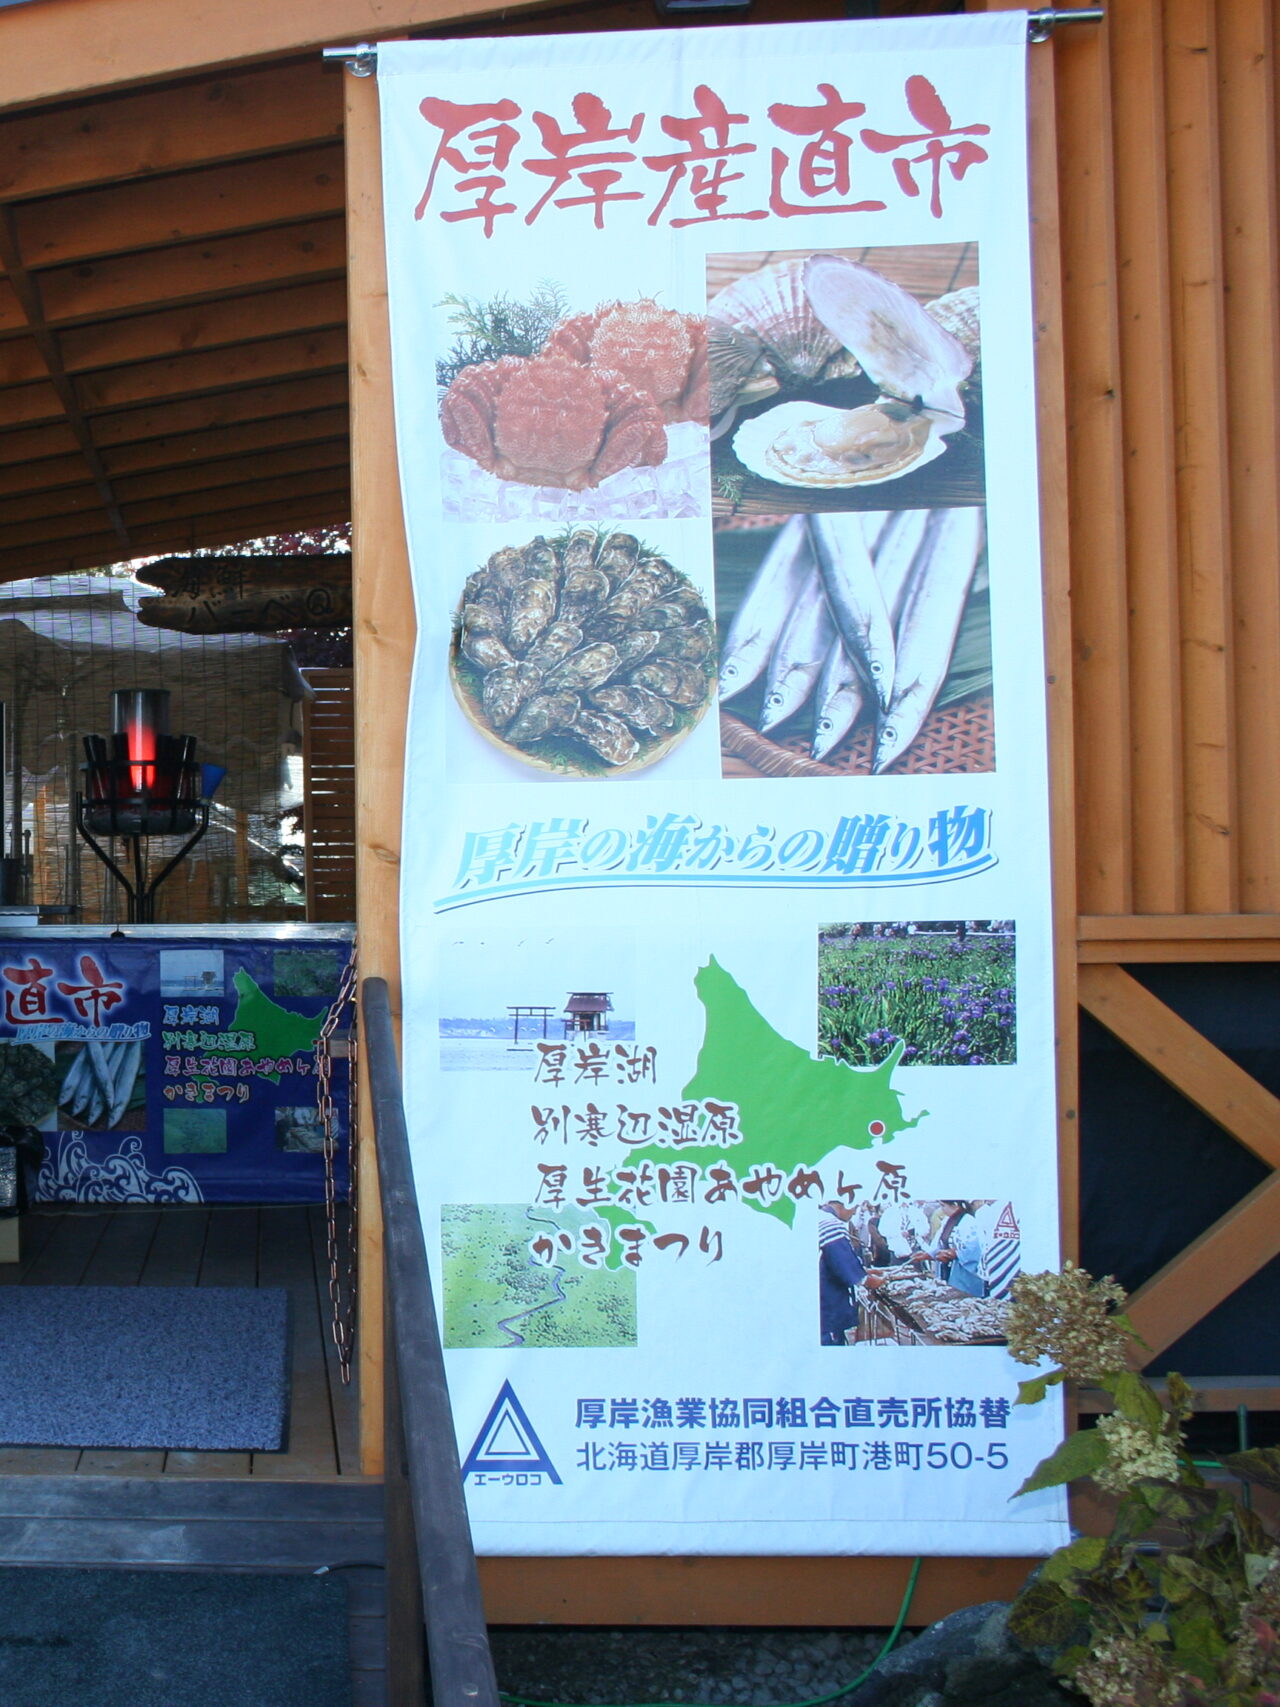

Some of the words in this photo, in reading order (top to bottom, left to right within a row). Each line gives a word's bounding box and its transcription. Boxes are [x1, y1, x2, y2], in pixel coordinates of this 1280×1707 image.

[415, 74, 991, 239] 厚岸産直市
[454, 804, 992, 890] 厚岸の海からの贈り物
[163, 1004, 219, 1026] 厚岸湖
[534, 1043, 657, 1087] 厚岸湖
[163, 1082, 250, 1103] かきまつり
[531, 1101, 738, 1146] 別寒辺湿原
[532, 1225, 724, 1268] かきまつり
[575, 1441, 1009, 1471] 北海道厚岸郡厚岸町港町50-5
[474, 1473, 542, 1486] エーウロコ
